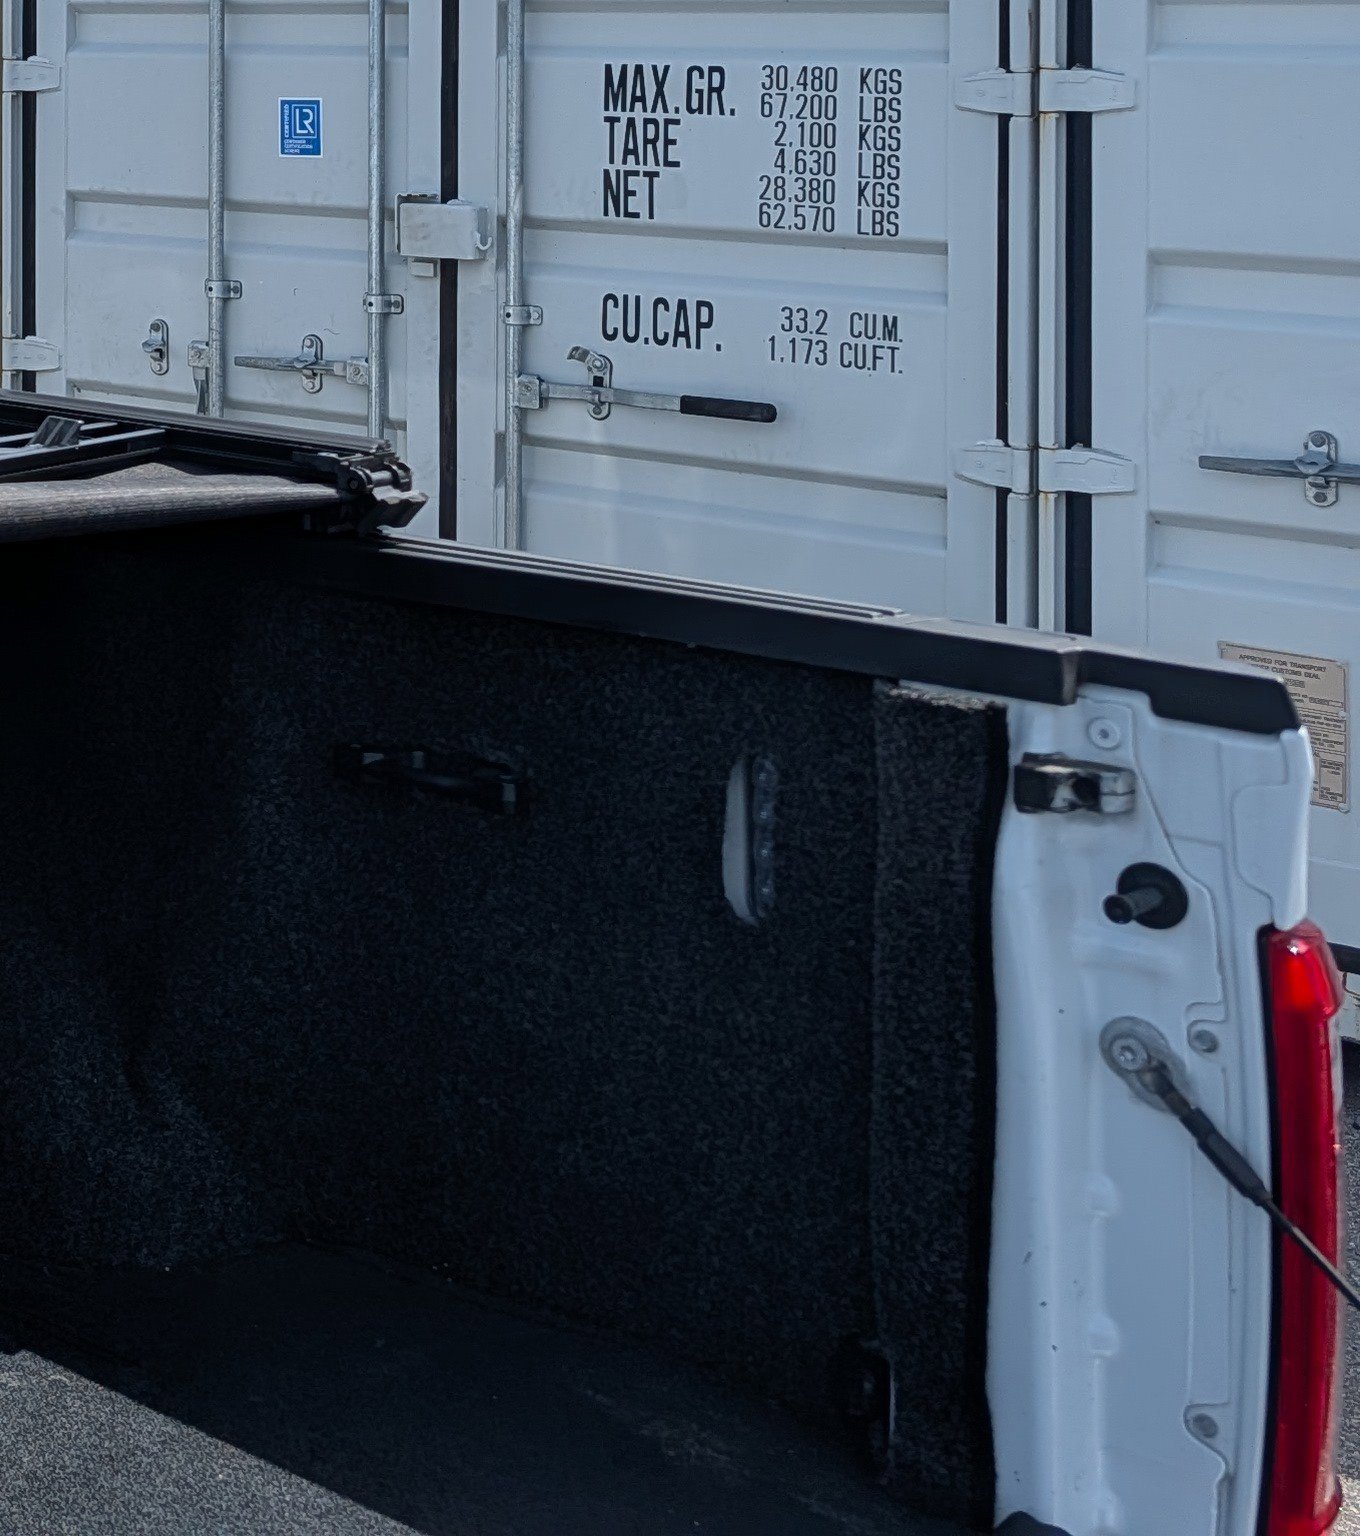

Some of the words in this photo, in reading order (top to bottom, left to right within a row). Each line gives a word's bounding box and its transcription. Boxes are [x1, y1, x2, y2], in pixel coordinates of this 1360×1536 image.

[760, 64, 838, 93] 30,480
[859, 67, 902, 95] KGS
[295, 108, 315, 134] LR
[760, 92, 838, 121] 67,200
[858, 96, 902, 124] LBS
[603, 116, 682, 168] TARE
[774, 120, 837, 149] 2,100
[858, 124, 902, 152] KGS
[774, 149, 836, 177] 4,630
[858, 152, 901, 181] LBS
[602, 168, 660, 220] NET
[758, 174, 836, 205] 28,380
[857, 180, 900, 208] KGS
[758, 202, 836, 233] 62,570
[856, 208, 900, 238] LBS
[780, 306, 828, 336] 33.2
[849, 311, 904, 343] CU.M.
[840, 342, 903, 374] CU.FT.
[1238, 654, 1272, 664] APPROVED
[1289, 661, 1327, 672] TRANSPORT
